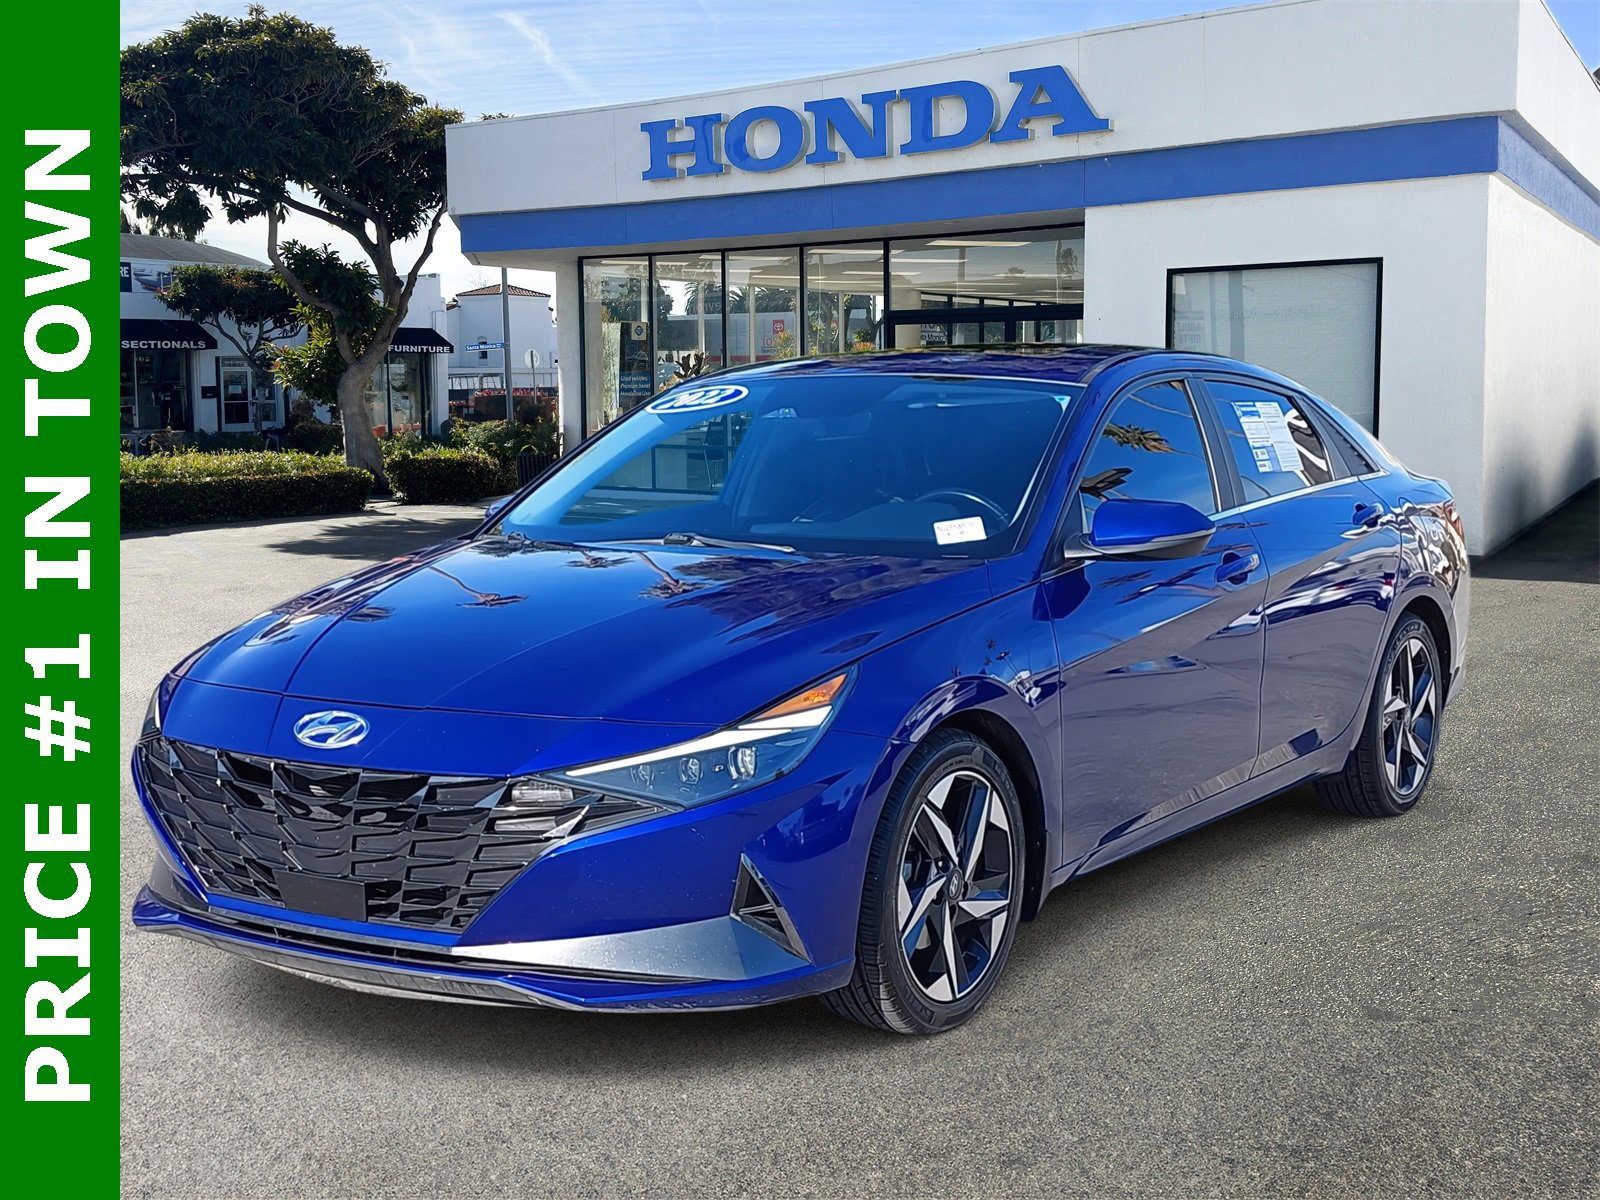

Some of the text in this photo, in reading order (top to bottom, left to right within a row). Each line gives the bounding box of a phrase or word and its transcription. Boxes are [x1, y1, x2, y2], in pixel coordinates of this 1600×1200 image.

[640, 64, 1113, 182] HONDA
[121, 340, 206, 349] SECTIONALS
[388, 344, 451, 353] FURNITURE
